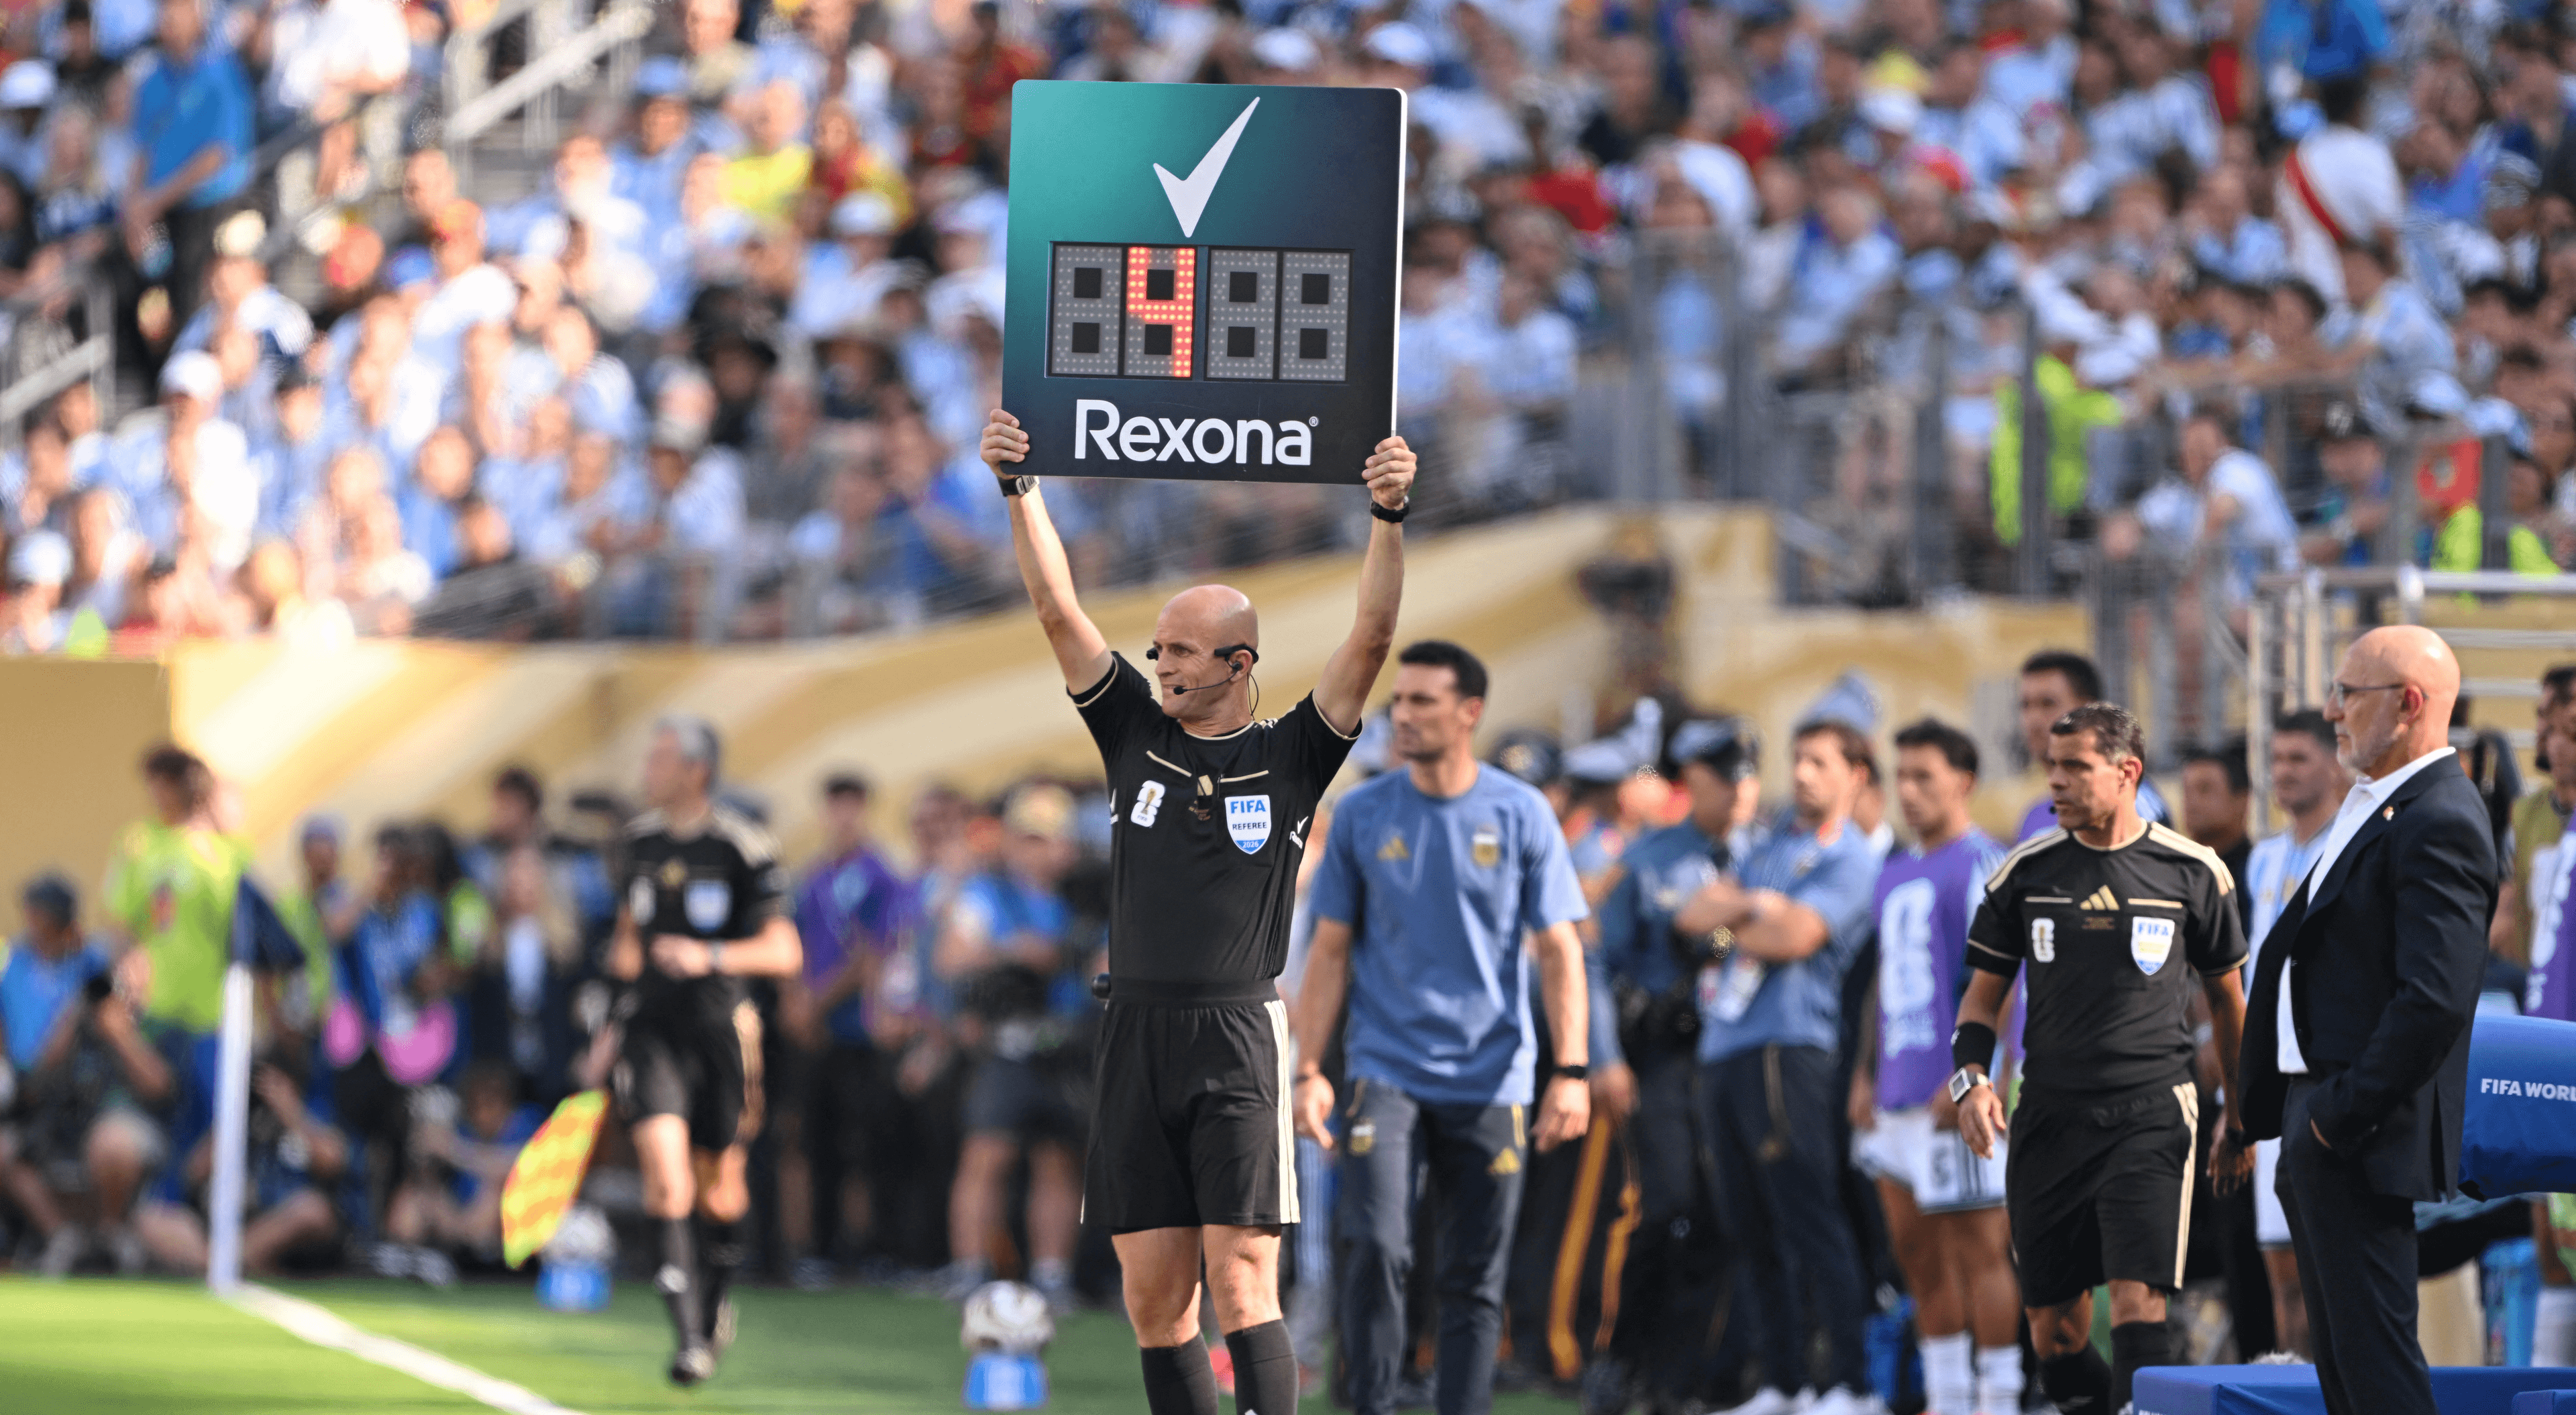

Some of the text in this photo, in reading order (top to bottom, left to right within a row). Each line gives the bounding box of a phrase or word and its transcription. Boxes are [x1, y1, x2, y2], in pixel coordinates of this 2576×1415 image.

[1127, 247, 1195, 377] 4
[1230, 800, 1266, 814] FIFA
[1232, 822, 1267, 830] REFEREE
[2138, 923, 2169, 936] FIFA
[2481, 1078, 2522, 1096] FIFA
